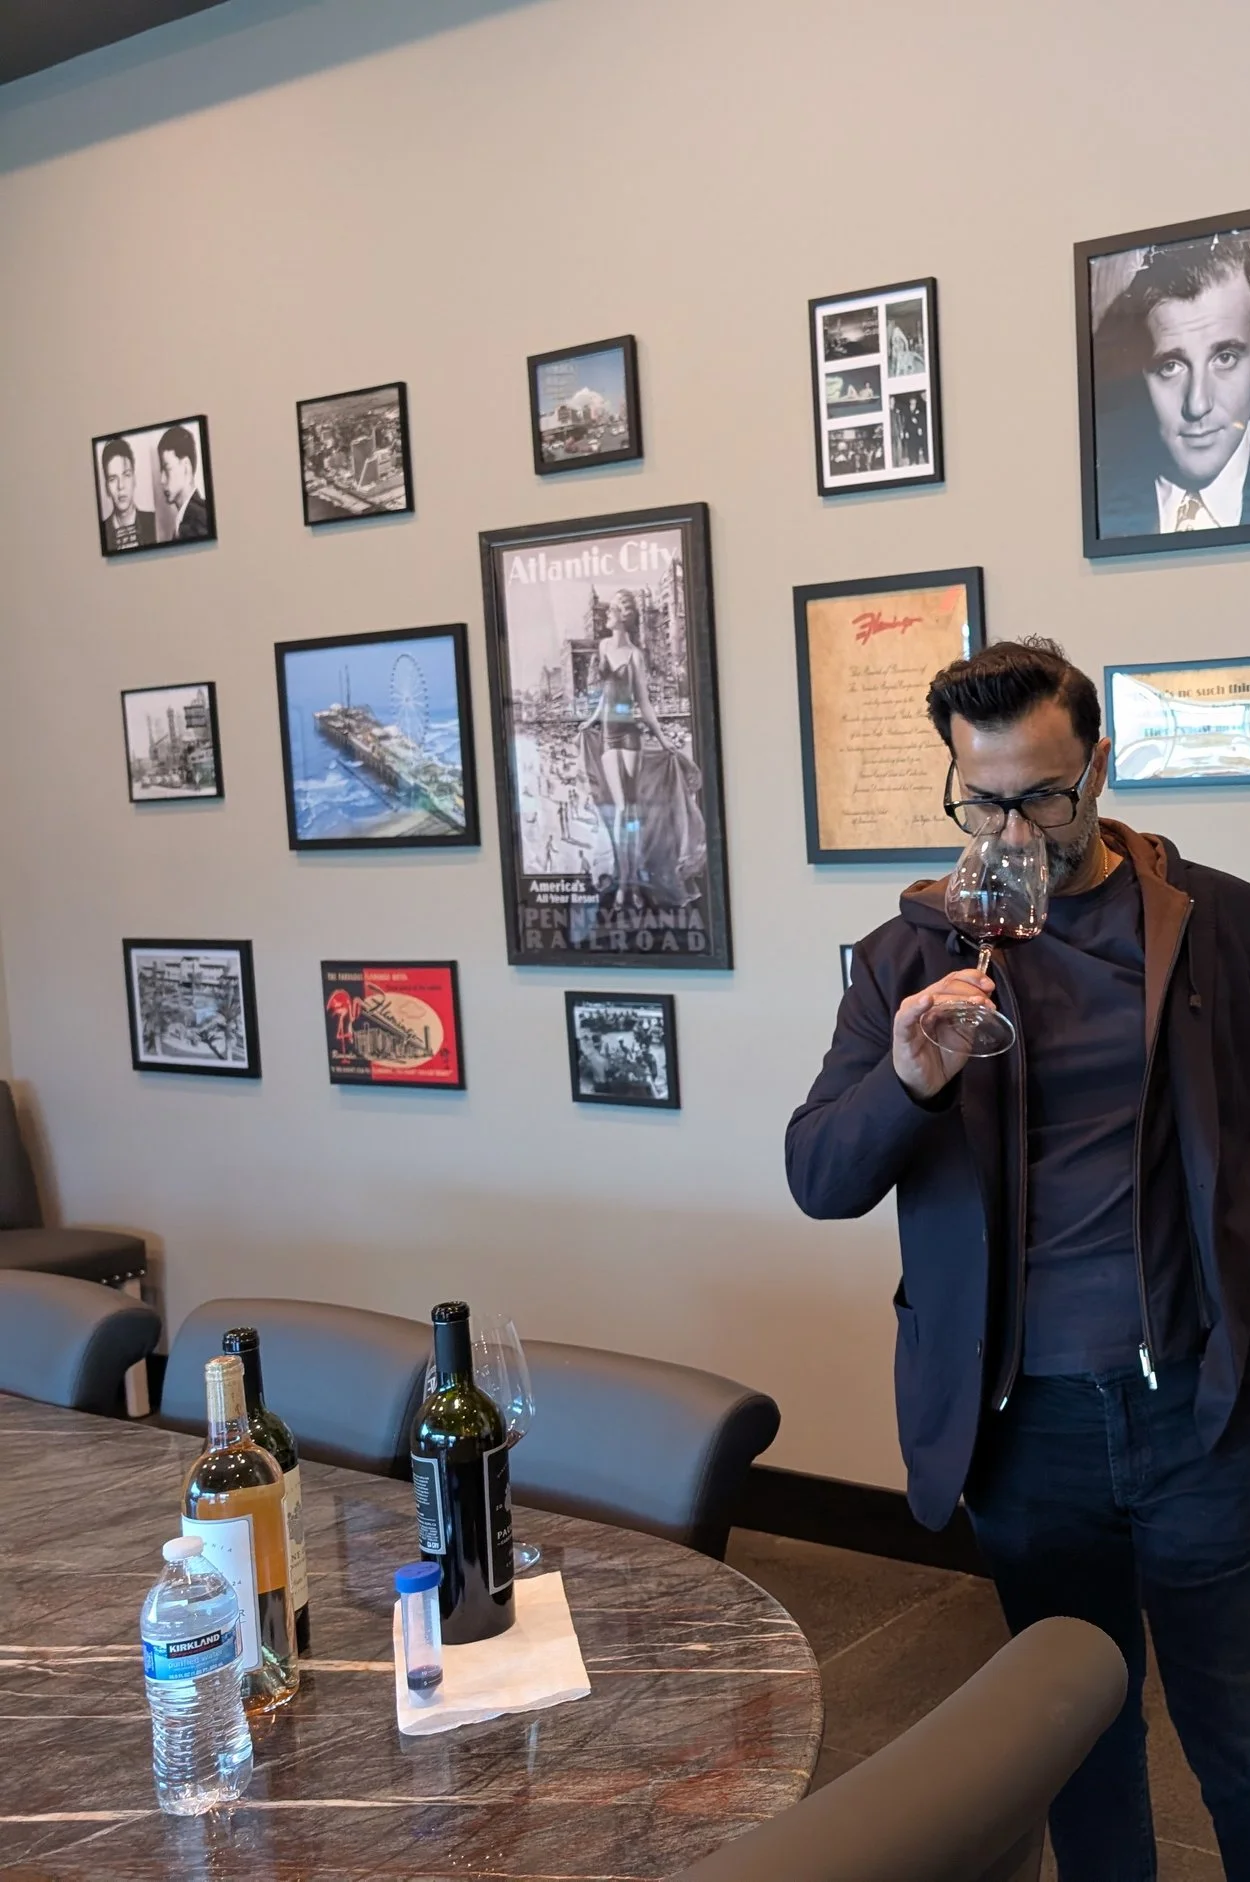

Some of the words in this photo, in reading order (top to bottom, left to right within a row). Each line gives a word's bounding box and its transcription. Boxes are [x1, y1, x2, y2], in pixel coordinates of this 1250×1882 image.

[507, 545, 614, 588] Atlantic
[619, 540, 678, 574] City
[1196, 684, 1225, 697] such
[530, 879, 586, 893] America's
[571, 893, 600, 903] Resort
[525, 907, 705, 930] PENNSYLVANIA
[525, 929, 706, 951] RAILROAD
[169, 1633, 221, 1653] KIRKLAND
[168, 1657, 199, 1669] purified
